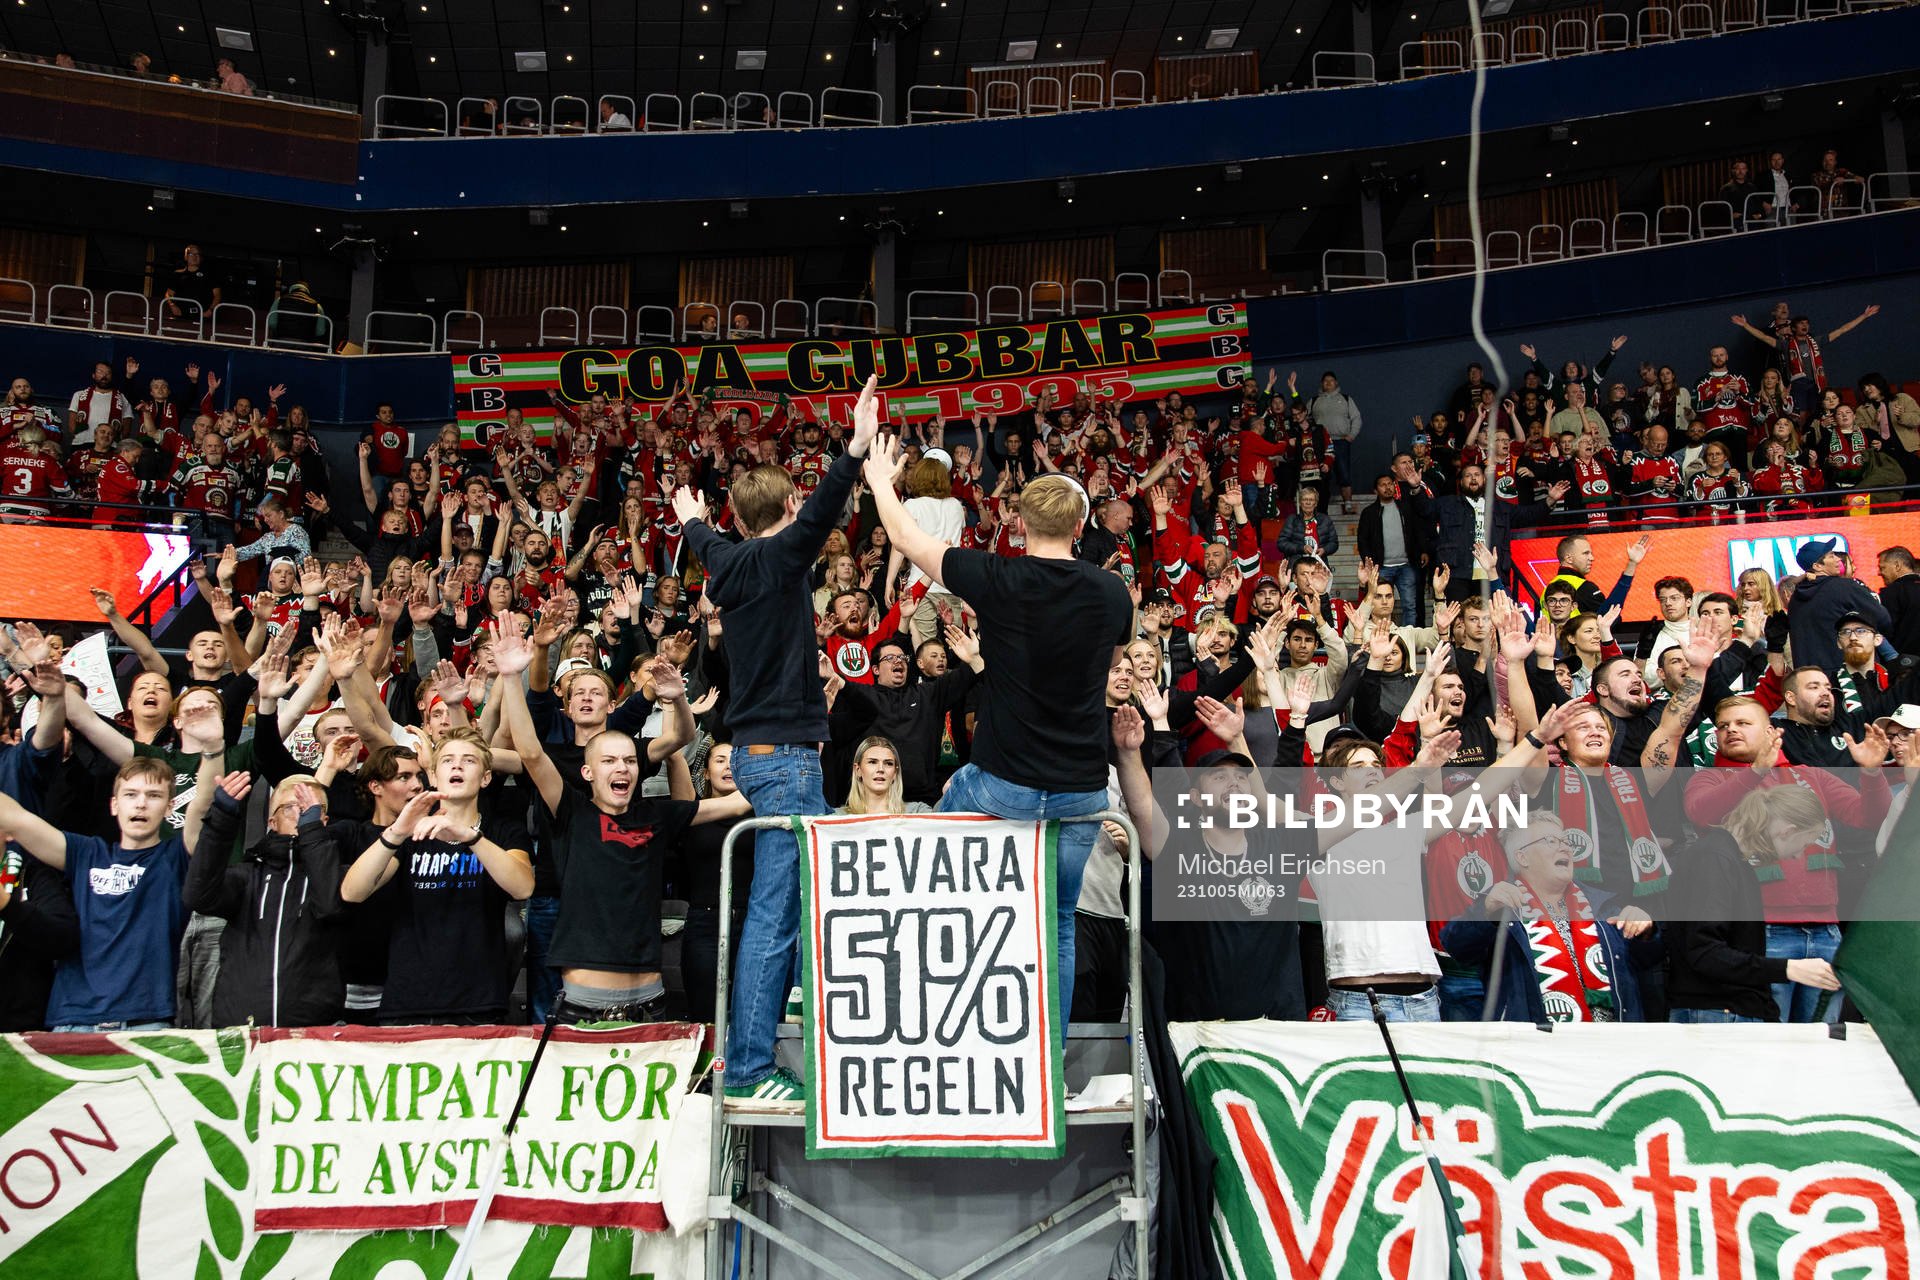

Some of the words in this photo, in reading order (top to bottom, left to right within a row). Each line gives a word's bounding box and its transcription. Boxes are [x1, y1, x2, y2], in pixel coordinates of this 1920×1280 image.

[558, 345, 756, 404] GOA
[786, 314, 1160, 393] GUBBAR
[926, 370, 1135, 420] 1995
[3, 456, 46, 468] SERNEKE
[13, 468, 33, 494] 3
[410, 851, 484, 877] TRAPSTA
[831, 836, 1025, 897] BEVARA
[555, 1048, 678, 1122] FÖR
[840, 1055, 1026, 1117] REGELN
[271, 1142, 341, 1194] DE
[1224, 1100, 1911, 1280] Västra
